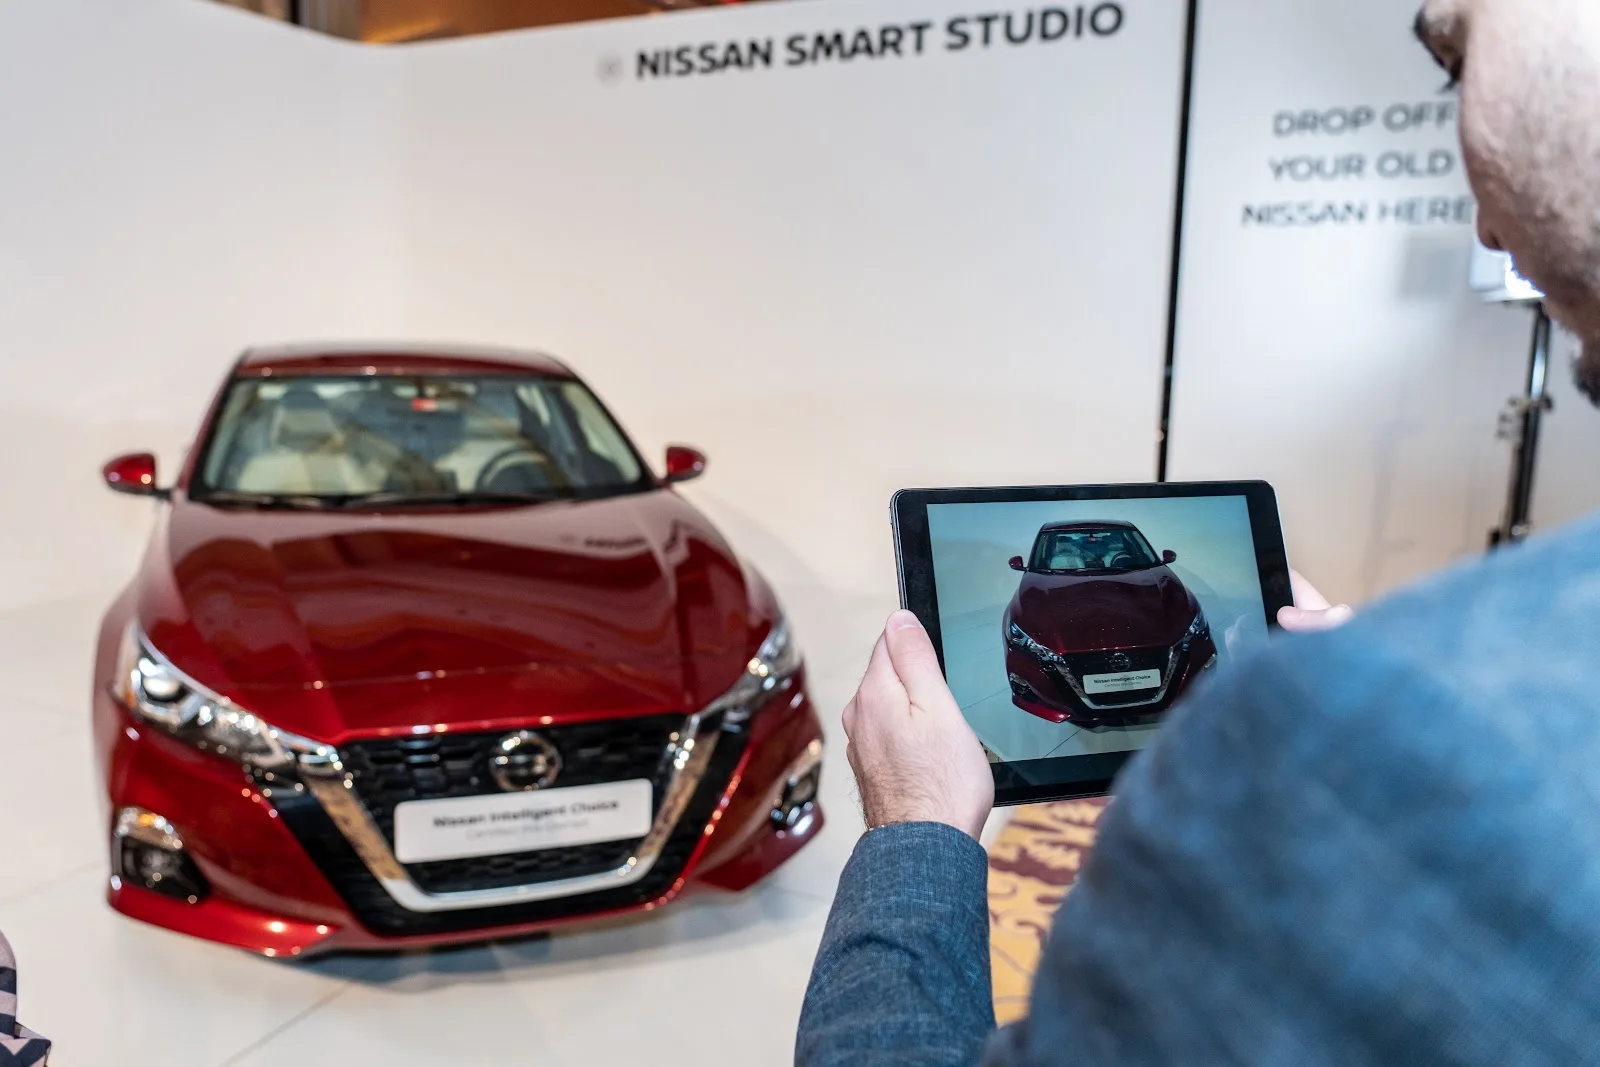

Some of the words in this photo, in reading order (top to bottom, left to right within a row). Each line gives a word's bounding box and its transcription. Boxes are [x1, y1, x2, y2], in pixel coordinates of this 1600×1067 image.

[635, 39, 773, 81] NISSAN
[786, 22, 931, 67] SMART
[945, 3, 1124, 51] STUDIO
[1273, 105, 1376, 137] DROP
[1382, 101, 1457, 133] OFF
[1269, 153, 1366, 181] YOUR
[1376, 148, 1455, 180] OLD
[1242, 201, 1366, 225] NISSAN
[1377, 196, 1475, 224] HERE
[433, 813, 485, 828] Nissan
